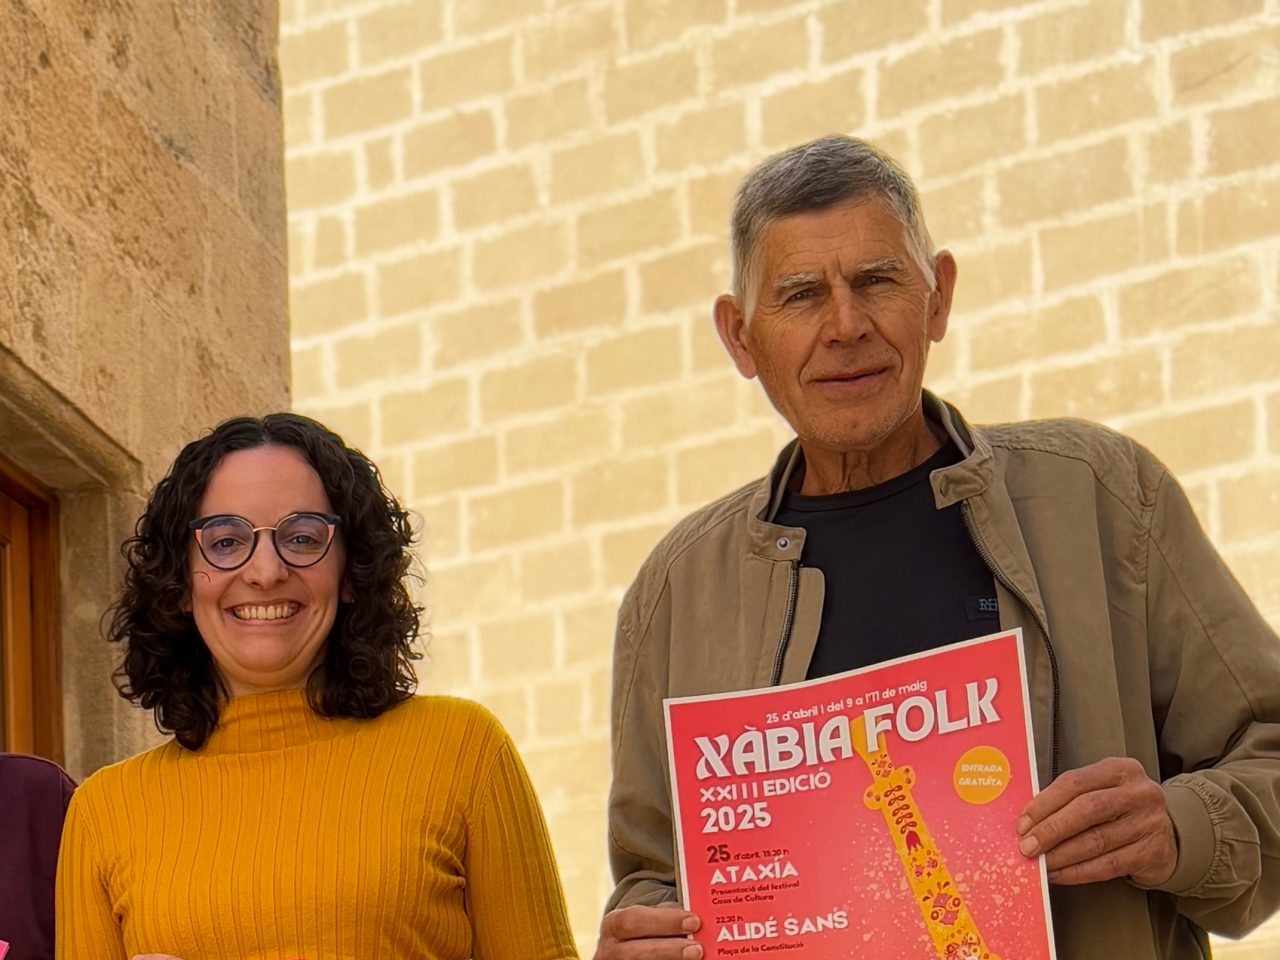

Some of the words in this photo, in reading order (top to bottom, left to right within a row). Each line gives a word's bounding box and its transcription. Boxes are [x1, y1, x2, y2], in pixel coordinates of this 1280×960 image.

[766, 714, 779, 724] 25
[782, 706, 818, 722] d'abril
[827, 700, 844, 713] del
[847, 698, 853, 708] 9
[856, 698, 863, 706] a
[882, 688, 896, 699] de
[899, 680, 928, 695] maig
[694, 726, 854, 781] XÀBIA
[864, 678, 1001, 753] FOLK
[763, 767, 831, 797] EDICIÓ
[961, 764, 1003, 773] ENTRADA
[700, 802, 771, 834] 2025
[707, 844, 730, 864] 25
[710, 856, 799, 885] ATAXÍA
[771, 881, 800, 890] festival
[716, 916, 778, 942] ALIDÉ
[784, 911, 848, 935] SANS
[718, 948, 739, 957] Plaça
[761, 942, 804, 952] Constitució
